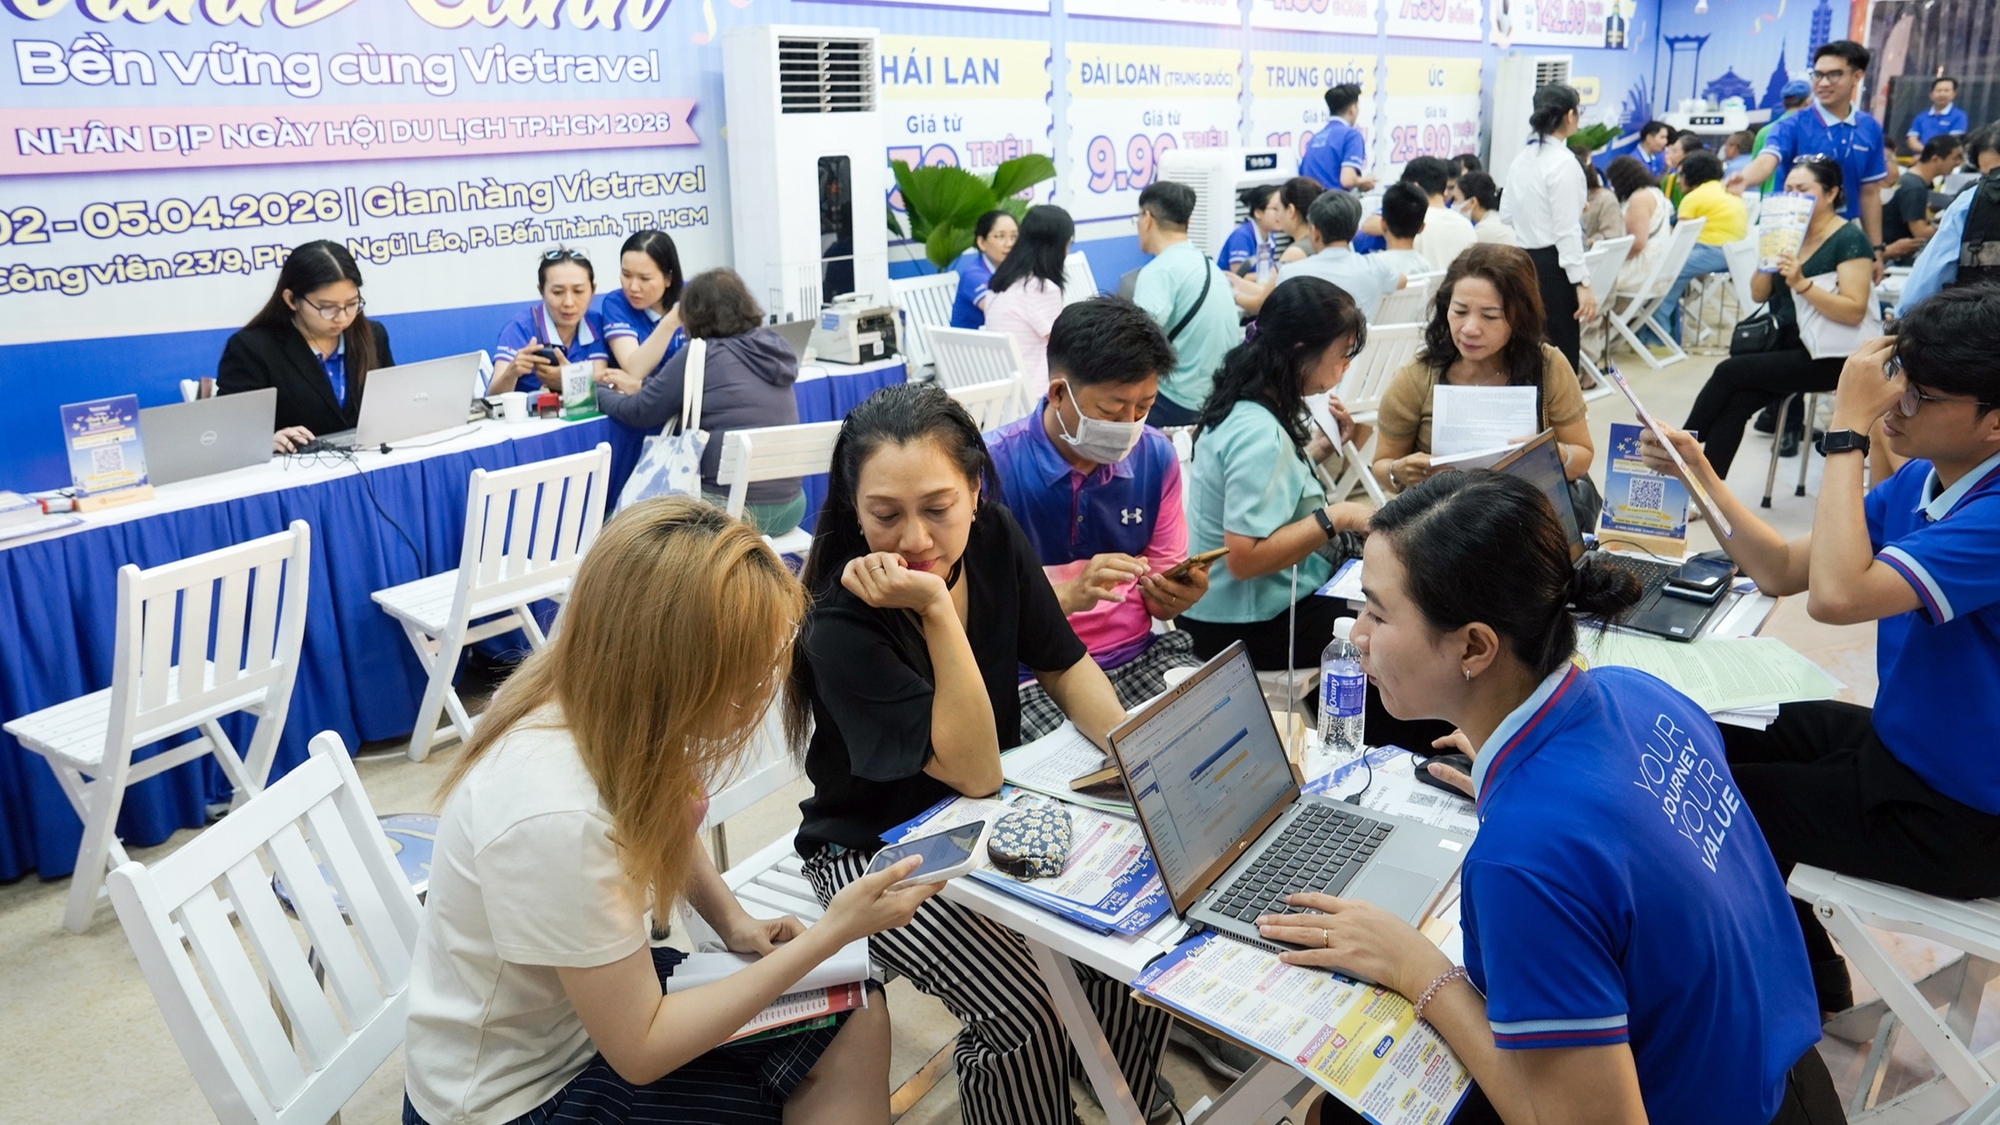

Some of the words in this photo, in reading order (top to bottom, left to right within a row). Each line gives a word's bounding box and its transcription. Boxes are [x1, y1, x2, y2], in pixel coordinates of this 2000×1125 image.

[13, 32, 156, 85] Bền
[159, 41, 322, 98] vững
[329, 43, 457, 96] cùng
[460, 43, 660, 83] Vietravel
[880, 47, 932, 84] HÁI
[944, 56, 999, 84] LAN
[1081, 56, 1111, 84] ĐÀI
[1116, 63, 1160, 85] LOAN
[1164, 72, 1201, 87] (TRUNG
[1203, 69, 1233, 87] QUỐC)
[1267, 66, 1318, 87] TRUNG
[1324, 59, 1364, 88] QUỐC
[1428, 65, 1444, 87] ÚC
[16, 120, 145, 155] NHÂN
[150, 124, 214, 157] DỊP
[221, 116, 319, 149] NGÀY
[325, 115, 385, 150] HỘI
[391, 119, 433, 142] DU
[439, 117, 506, 145] LỊCH
[510, 114, 611, 138] TP.HCM
[614, 112, 670, 134] 2026
[906, 113, 936, 134] Giá
[944, 113, 963, 133] từ
[1143, 110, 1163, 126] Giá
[1168, 110, 1181, 125] từ
[1390, 124, 1451, 164] 25.90
[81, 189, 343, 239] 05.04.2026
[362, 181, 455, 219] Gian
[458, 177, 555, 214] hàng
[554, 165, 705, 203] Vietravel
[89, 254, 171, 285] viên
[173, 248, 250, 278] 23/9,
[347, 233, 407, 266] Ngũ
[409, 230, 468, 254] Lão,
[469, 227, 494, 250] P.
[495, 217, 545, 246] Bến
[545, 215, 623, 242] Thành,
[659, 205, 708, 229] HCM
[1633, 713, 1684, 798] YOUR
[1662, 738, 1698, 825] JOURNEY
[1678, 758, 1723, 849] YOUR
[1701, 785, 1740, 873] VALUE
[1305, 1042, 1320, 1058] TRUNG
